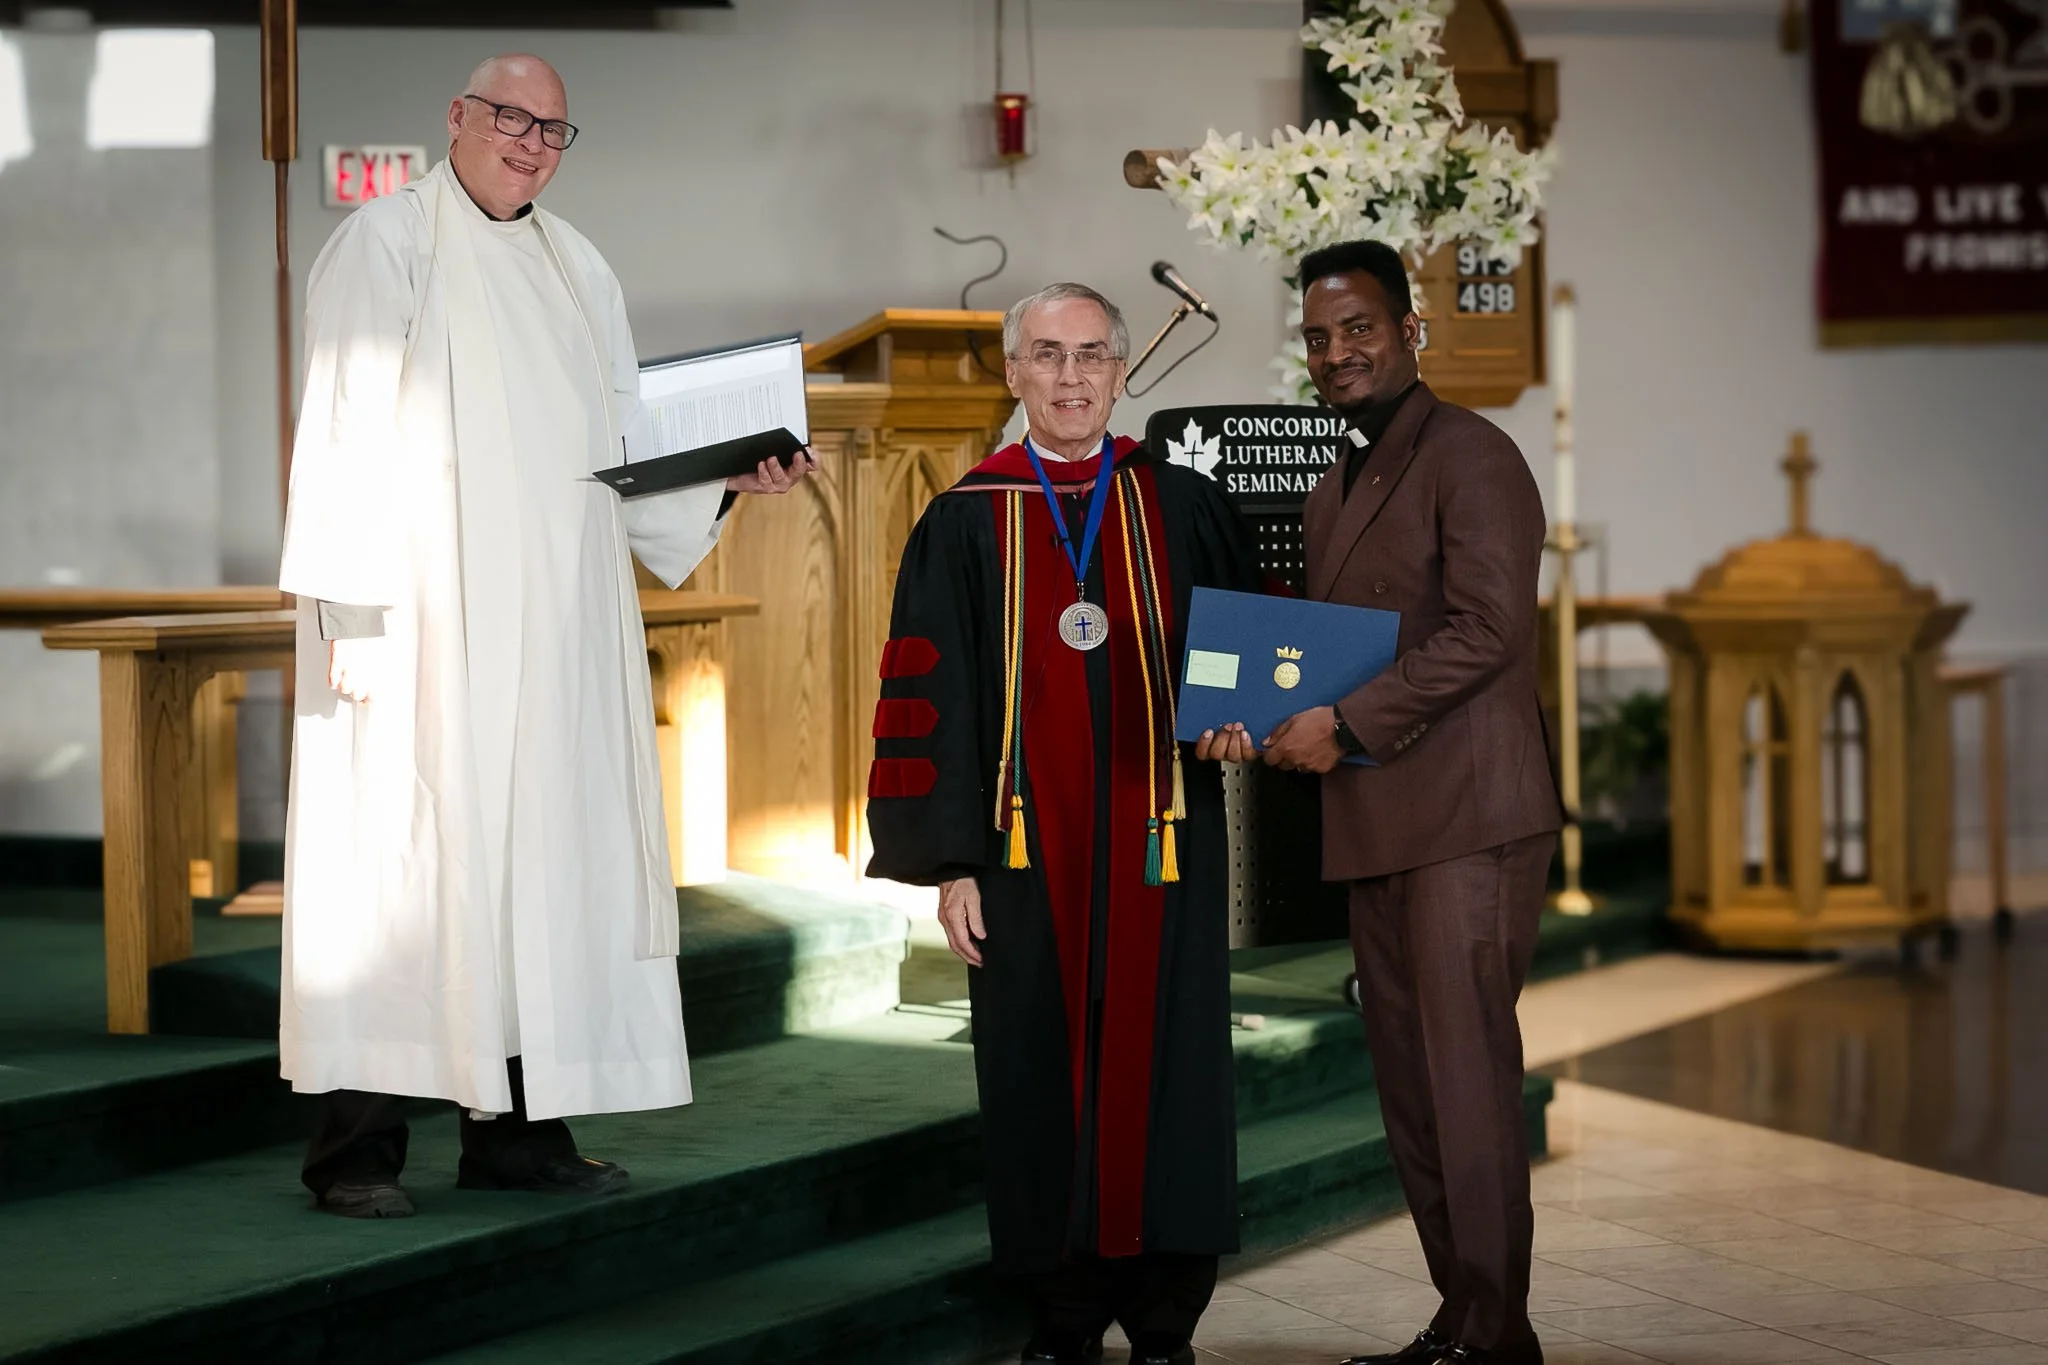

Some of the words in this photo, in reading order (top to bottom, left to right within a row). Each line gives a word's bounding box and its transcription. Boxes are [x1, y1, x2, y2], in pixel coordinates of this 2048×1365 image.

[336, 151, 412, 203] EXIT
[1840, 186, 1918, 224] AND
[1934, 184, 2023, 223] LIVE
[1459, 283, 1515, 312] 498
[1223, 417, 1347, 437] CONCORDIA
[1225, 445, 1337, 465] LUTHERAN
[1227, 473, 1325, 493] SEMINAR
